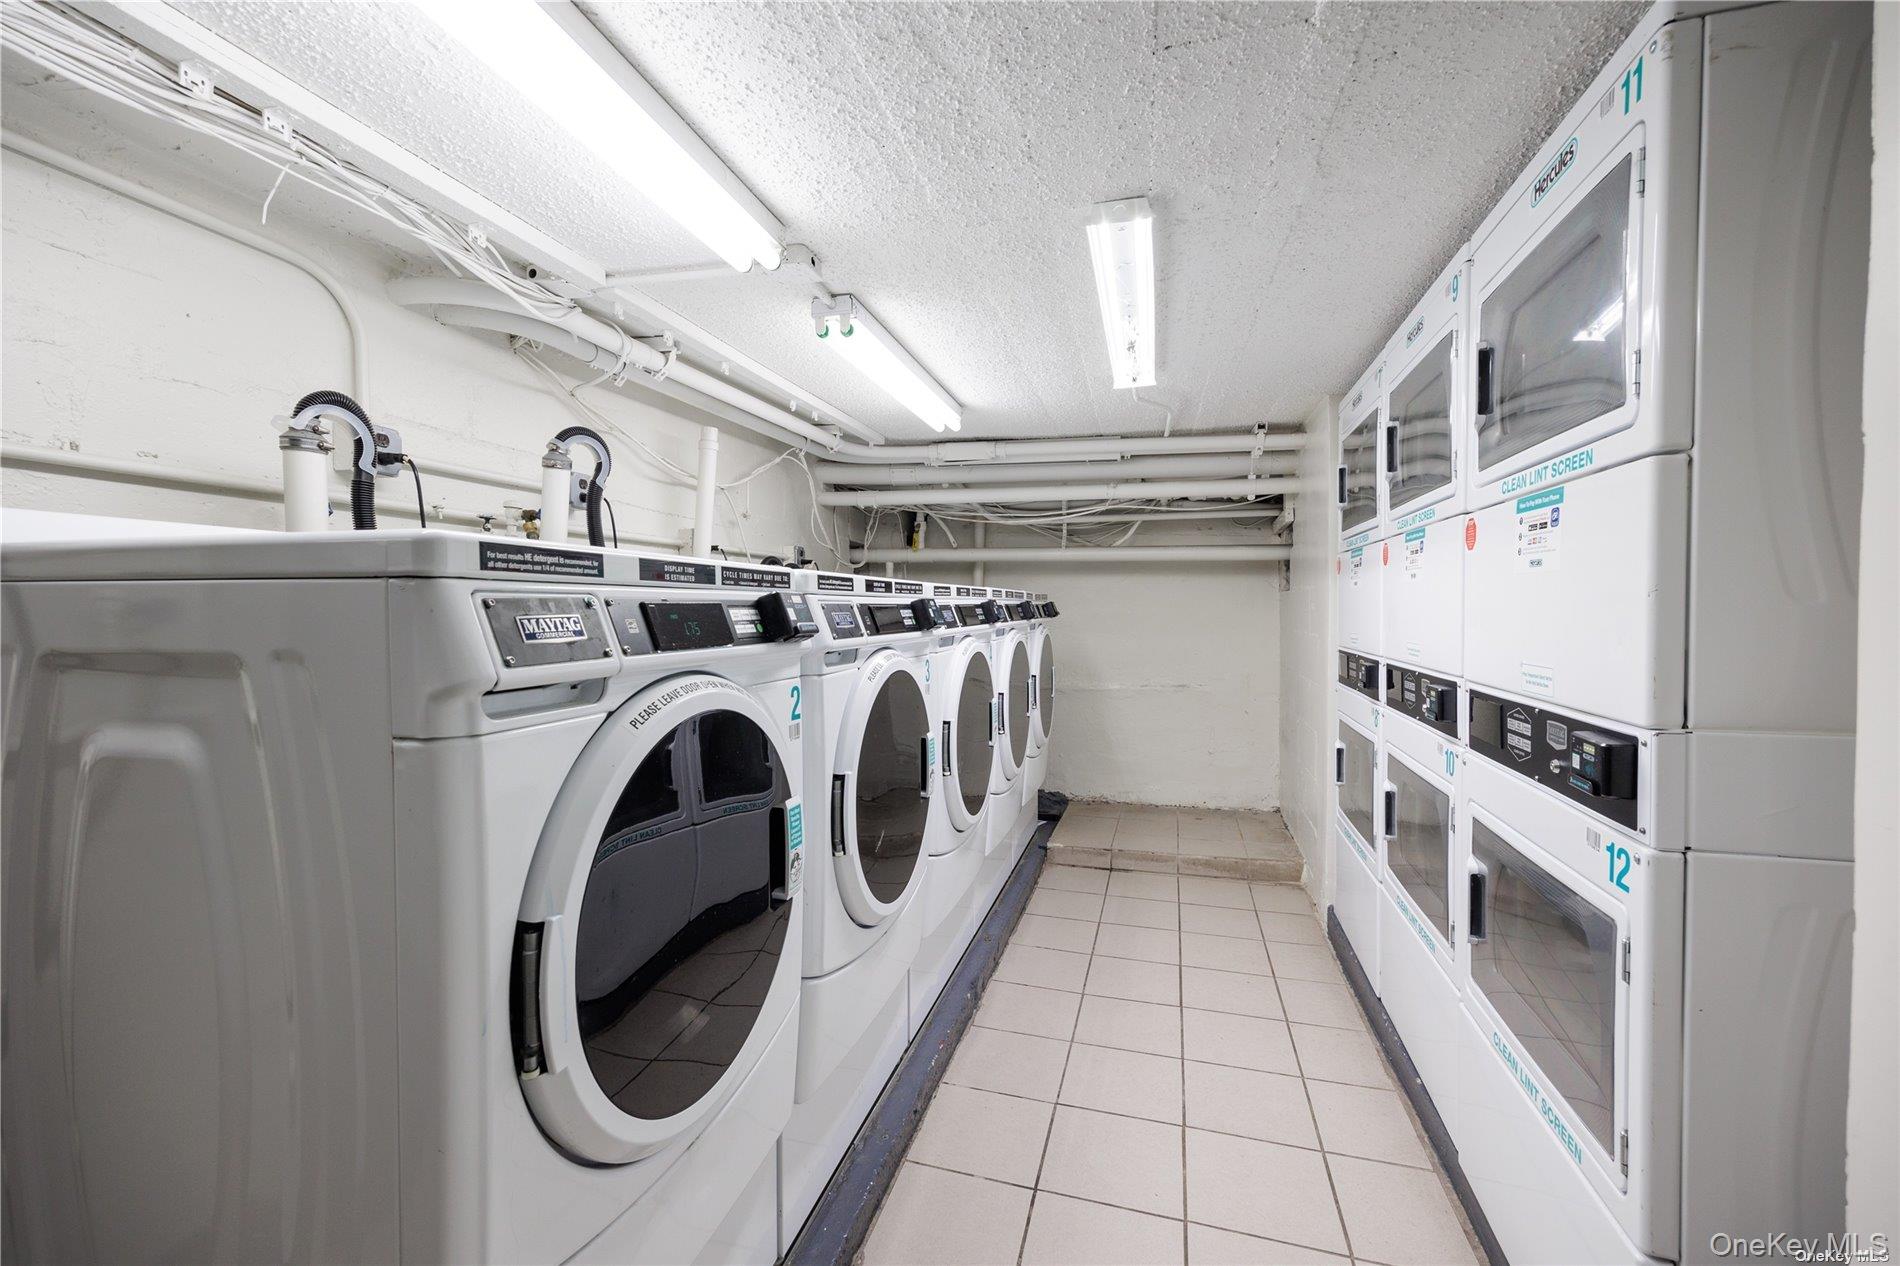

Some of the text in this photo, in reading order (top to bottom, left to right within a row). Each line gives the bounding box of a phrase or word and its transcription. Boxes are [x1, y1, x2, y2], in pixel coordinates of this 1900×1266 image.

[1621, 56, 1643, 116] 11
[1533, 144, 1574, 201] Hercules
[1452, 274, 1459, 302] 9
[1501, 448, 1594, 495] CLEAN LINT SCREEN
[495, 561, 508, 569] other
[508, 562, 533, 571] detergents
[496, 552, 507, 560] best
[524, 553, 532, 561] HE
[533, 554, 559, 565] detergent
[560, 556, 564, 564] is
[664, 565, 684, 573] DISPLAY
[671, 574, 695, 582] ESTIMATED
[723, 570, 738, 579] CYCLE
[739, 571, 752, 579] TIMES
[521, 617, 581, 634] MAYTAG
[535, 631, 575, 639] COMMERCIAL
[925, 659, 931, 682] 3
[629, 701, 661, 730] PLEASE
[660, 689, 683, 707] LEAVE
[681, 681, 701, 695] DOOR
[790, 686, 801, 720] 2
[1445, 749, 1455, 776] 10
[1606, 842, 1631, 894] 12
[1493, 1031, 1582, 1165] CLEAN LINT SCREEN
